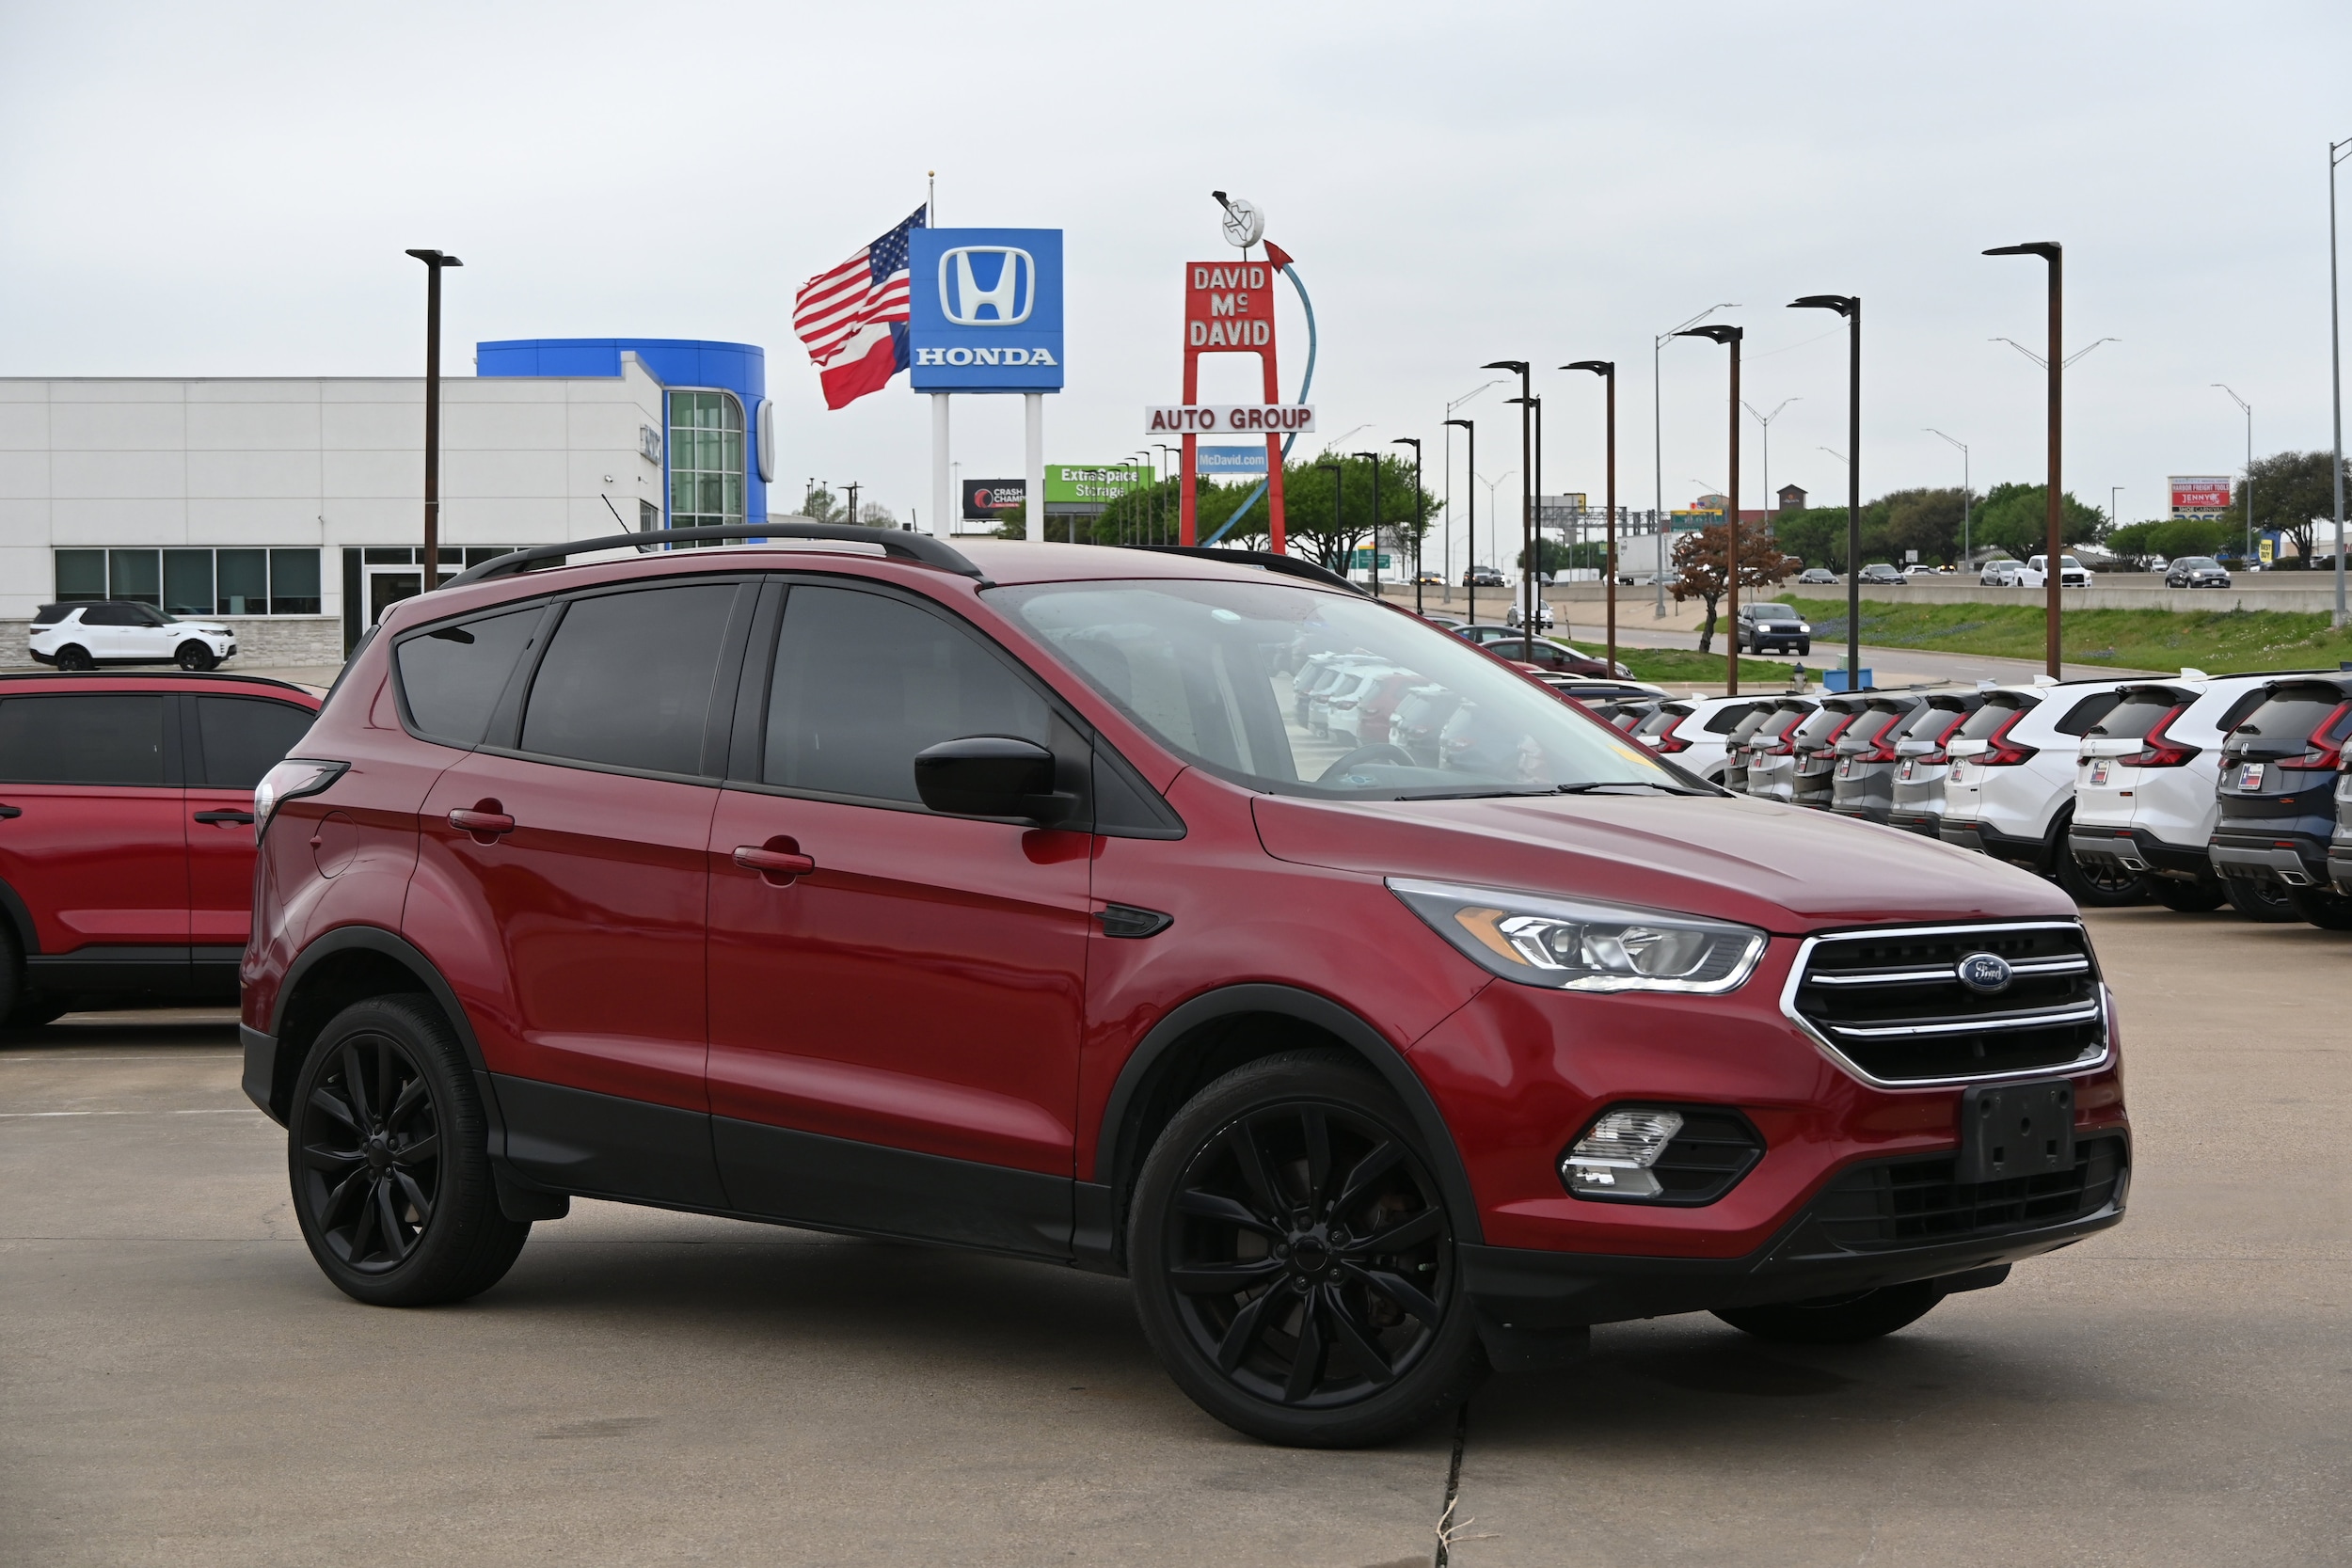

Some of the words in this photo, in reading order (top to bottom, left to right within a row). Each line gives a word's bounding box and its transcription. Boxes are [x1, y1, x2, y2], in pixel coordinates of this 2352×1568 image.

[1194, 266, 1265, 290] DAVID
[1190, 320, 1270, 346] DAVID
[915, 347, 1057, 366] HONDA
[1152, 408, 1216, 430] AUTO
[1230, 408, 1311, 429] GROUP
[1200, 454, 1265, 466] McDavid.com
[1075, 483, 1125, 499] Storage
[2182, 494, 2211, 503] JENNY
[1975, 960, 2003, 980] Ford
